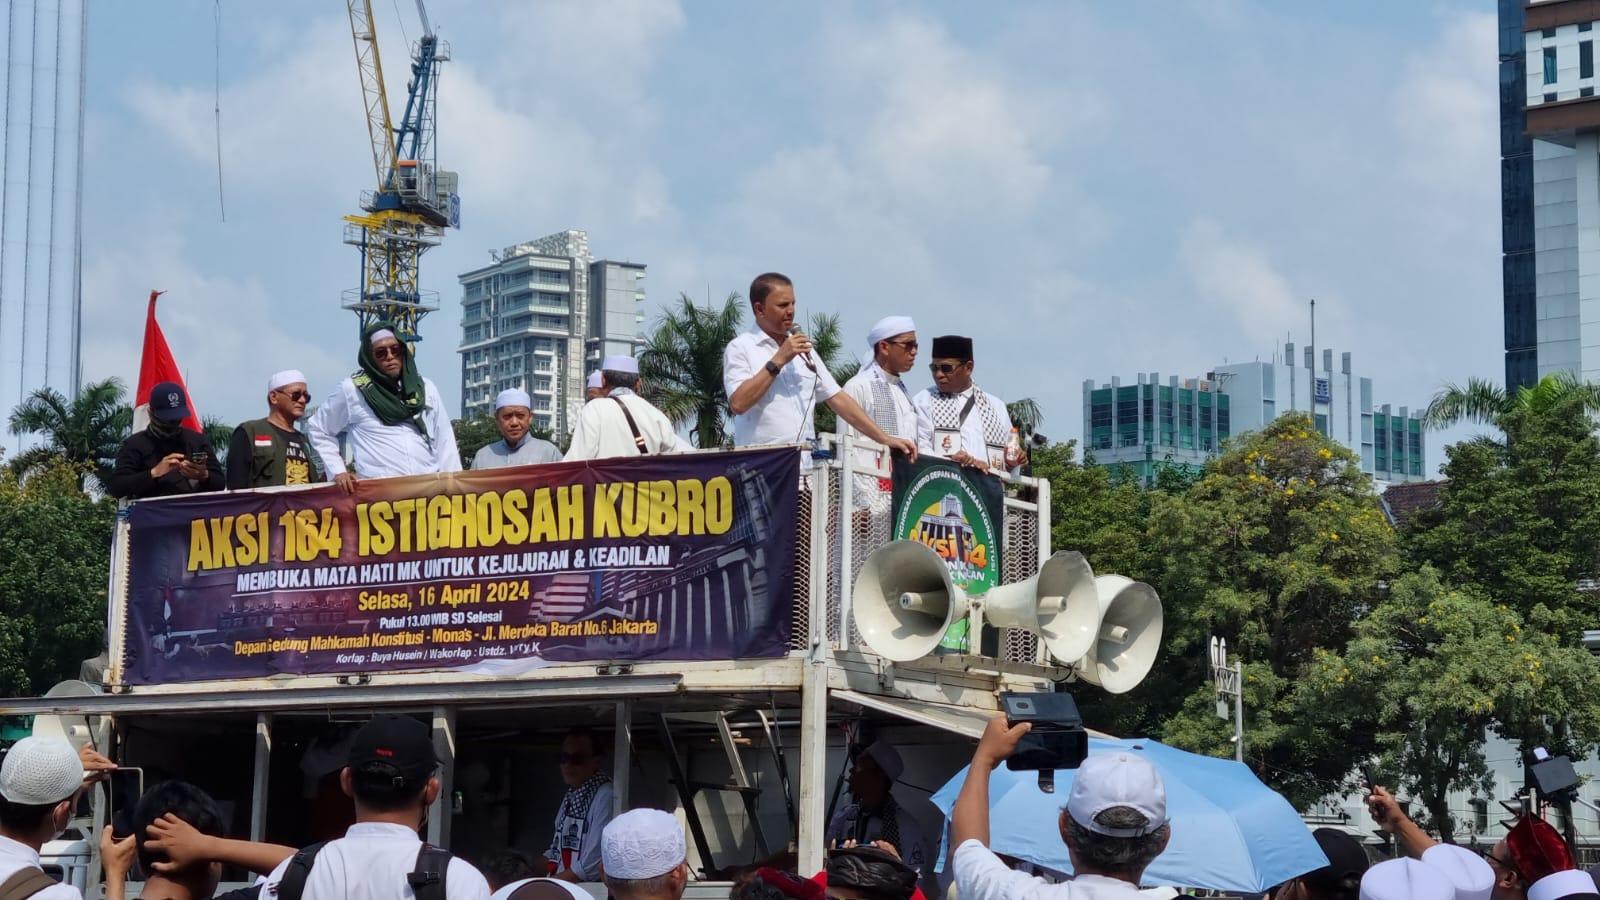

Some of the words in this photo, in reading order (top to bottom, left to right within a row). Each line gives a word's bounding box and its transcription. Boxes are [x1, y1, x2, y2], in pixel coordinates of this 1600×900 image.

[187, 511, 270, 572] AKSI
[279, 507, 342, 562] 164
[356, 484, 585, 557] ISTIGHOSAH
[593, 475, 734, 539] KUBRO
[236, 568, 311, 593] MEMBUKA
[313, 565, 357, 586] MATA
[360, 562, 394, 584] HATI
[397, 561, 420, 581] MK
[424, 556, 474, 577] UNTUK
[478, 549, 569, 575] KEJUJURAN
[573, 549, 587, 567] &
[588, 545, 670, 567] KEADILAN
[358, 590, 412, 612] Selasa,
[418, 586, 436, 606] 16
[440, 583, 481, 608] April
[486, 580, 530, 602] 2024
[234, 640, 266, 656] Depan
[310, 633, 370, 650] Mahkamah
[371, 630, 425, 648] Konstitusi
[550, 620, 583, 636] Barat
[584, 620, 608, 636] No.6
[609, 618, 658, 634] Jakarta
[379, 615, 405, 629] Pukul
[451, 612, 465, 624] SD
[467, 610, 503, 624] Selesai
[371, 651, 392, 664] Buya
